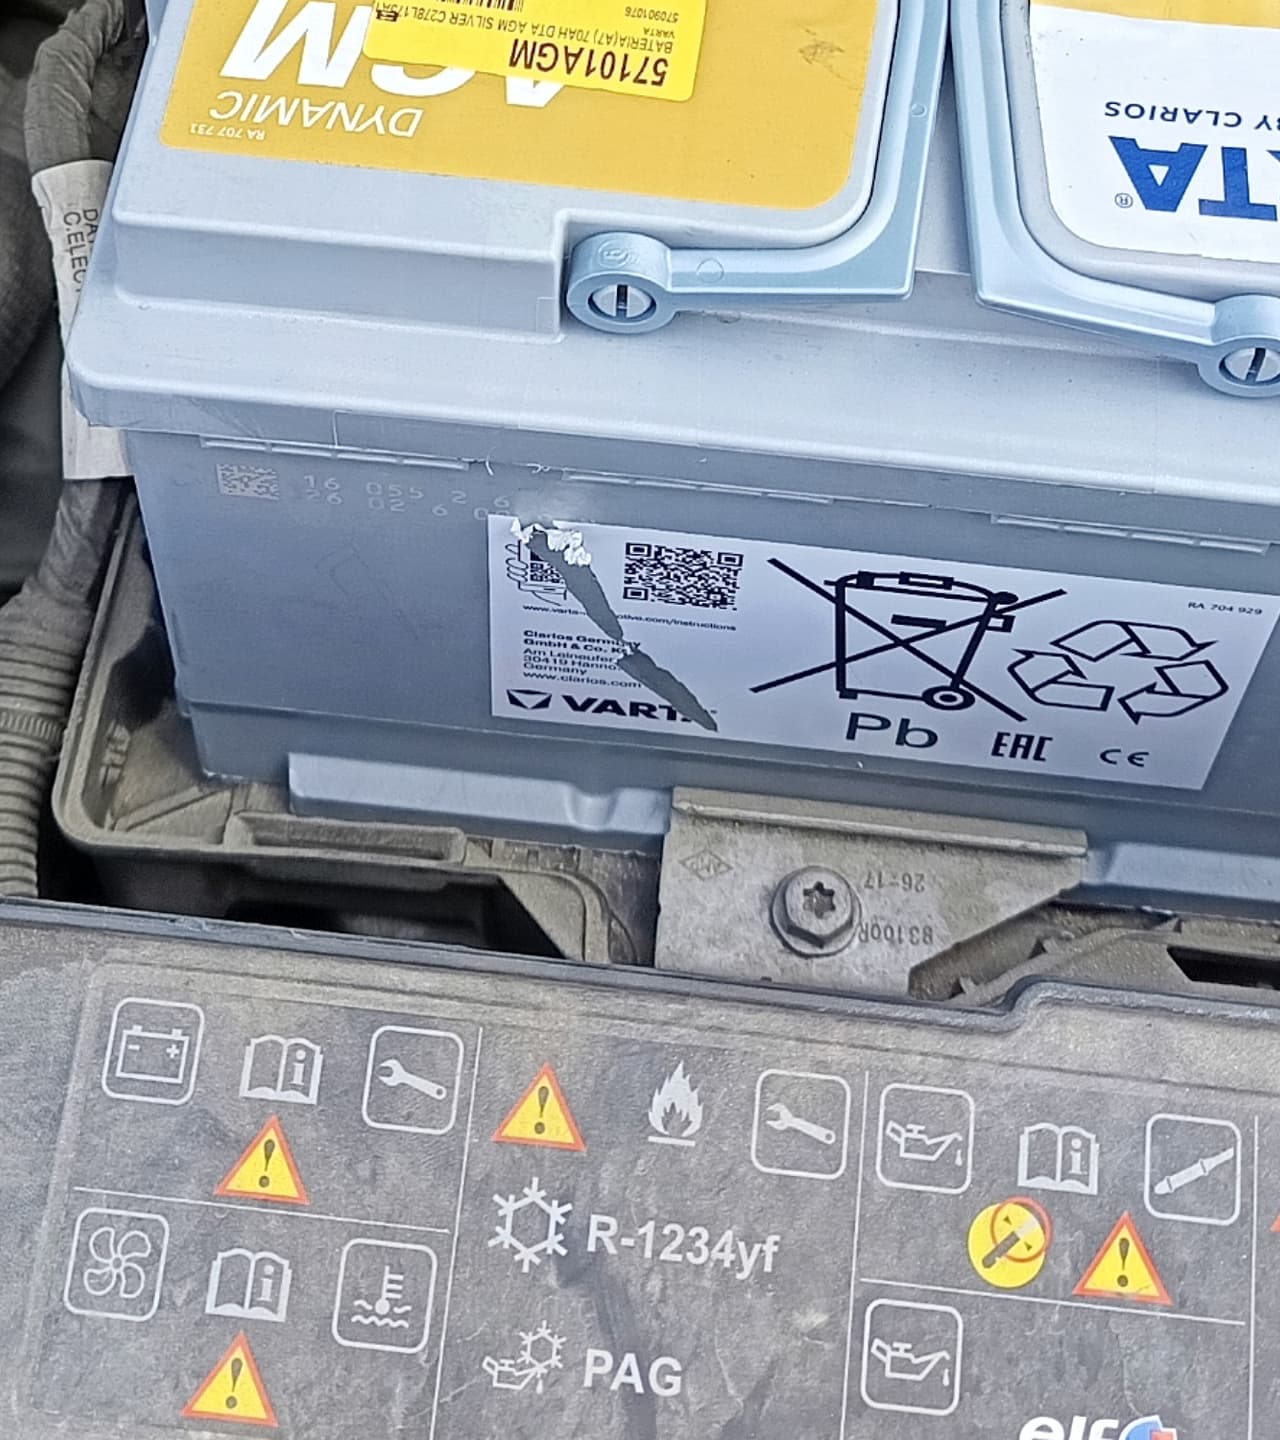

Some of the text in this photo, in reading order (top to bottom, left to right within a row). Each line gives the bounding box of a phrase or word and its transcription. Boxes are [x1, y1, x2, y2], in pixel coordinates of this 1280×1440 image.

[449, 13, 495, 31] SILVER
[624, 5, 680, 24] 570901076
[497, 17, 528, 35] AGM
[531, 22, 556, 39] DTA
[558, 26, 591, 44] 70AH
[643, 26, 676, 39] VARTA
[508, 38, 670, 87] 57101AGM
[208, 90, 424, 138] DYNAMIC
[1103, 100, 1243, 130] CLARIOS
[189, 122, 266, 141] RA 707 731
[1187, 601, 1206, 611] RA
[523, 629, 574, 642] Clarios
[523, 637, 568, 651] GmbH
[570, 642, 581, 651] &
[523, 647, 547, 658] Am
[523, 655, 623, 671] 30419 Hanno
[523, 661, 587, 676] Germany
[523, 671, 642, 689] www.clarios.com
[562, 695, 696, 724] VART
[844, 711, 940, 749] Pb
[990, 730, 1055, 762] EAC
[585, 1213, 781, 1279] R-1234yf
[583, 1349, 684, 1397] PAG
